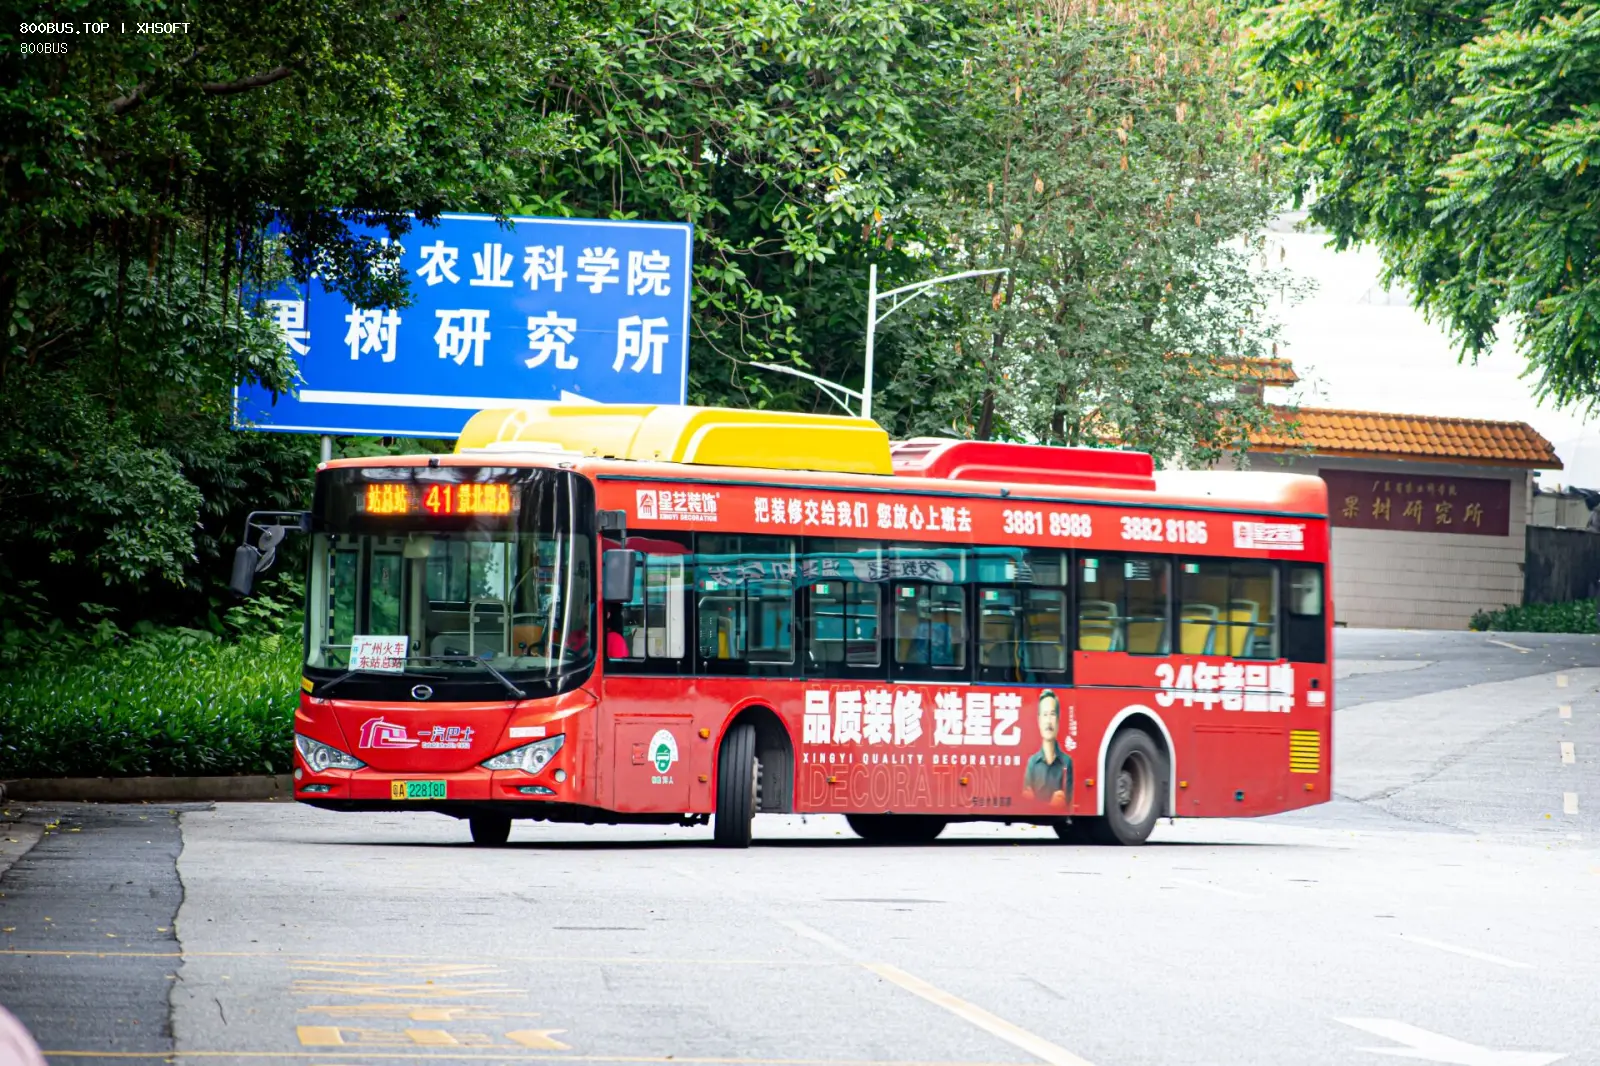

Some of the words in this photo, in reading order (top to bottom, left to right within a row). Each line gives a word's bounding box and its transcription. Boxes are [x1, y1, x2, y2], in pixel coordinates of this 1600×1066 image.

[426, 485, 451, 513] 41
[658, 490, 718, 513] 星艺装饰
[1342, 496, 1484, 528] 果树研究所
[754, 496, 869, 529] 把装修交给我们
[876, 502, 972, 532] 您放心上班去
[1002, 509, 1043, 535] 3881
[1049, 512, 1092, 538] 8988
[1120, 516, 1163, 541] 3882
[1166, 519, 1208, 544] 8186
[359, 656, 402, 668] 东站总站
[360, 642, 405, 655] 广州火车
[1155, 662, 1295, 713] 34年老品牌
[803, 689, 923, 745] 品质装修
[934, 693, 1022, 746] 选星艺
[417, 726, 475, 741] 一汽巴士
[803, 753, 853, 764] XINGYI
[862, 754, 924, 765] QUALITY
[932, 755, 1021, 766] DECORATION
